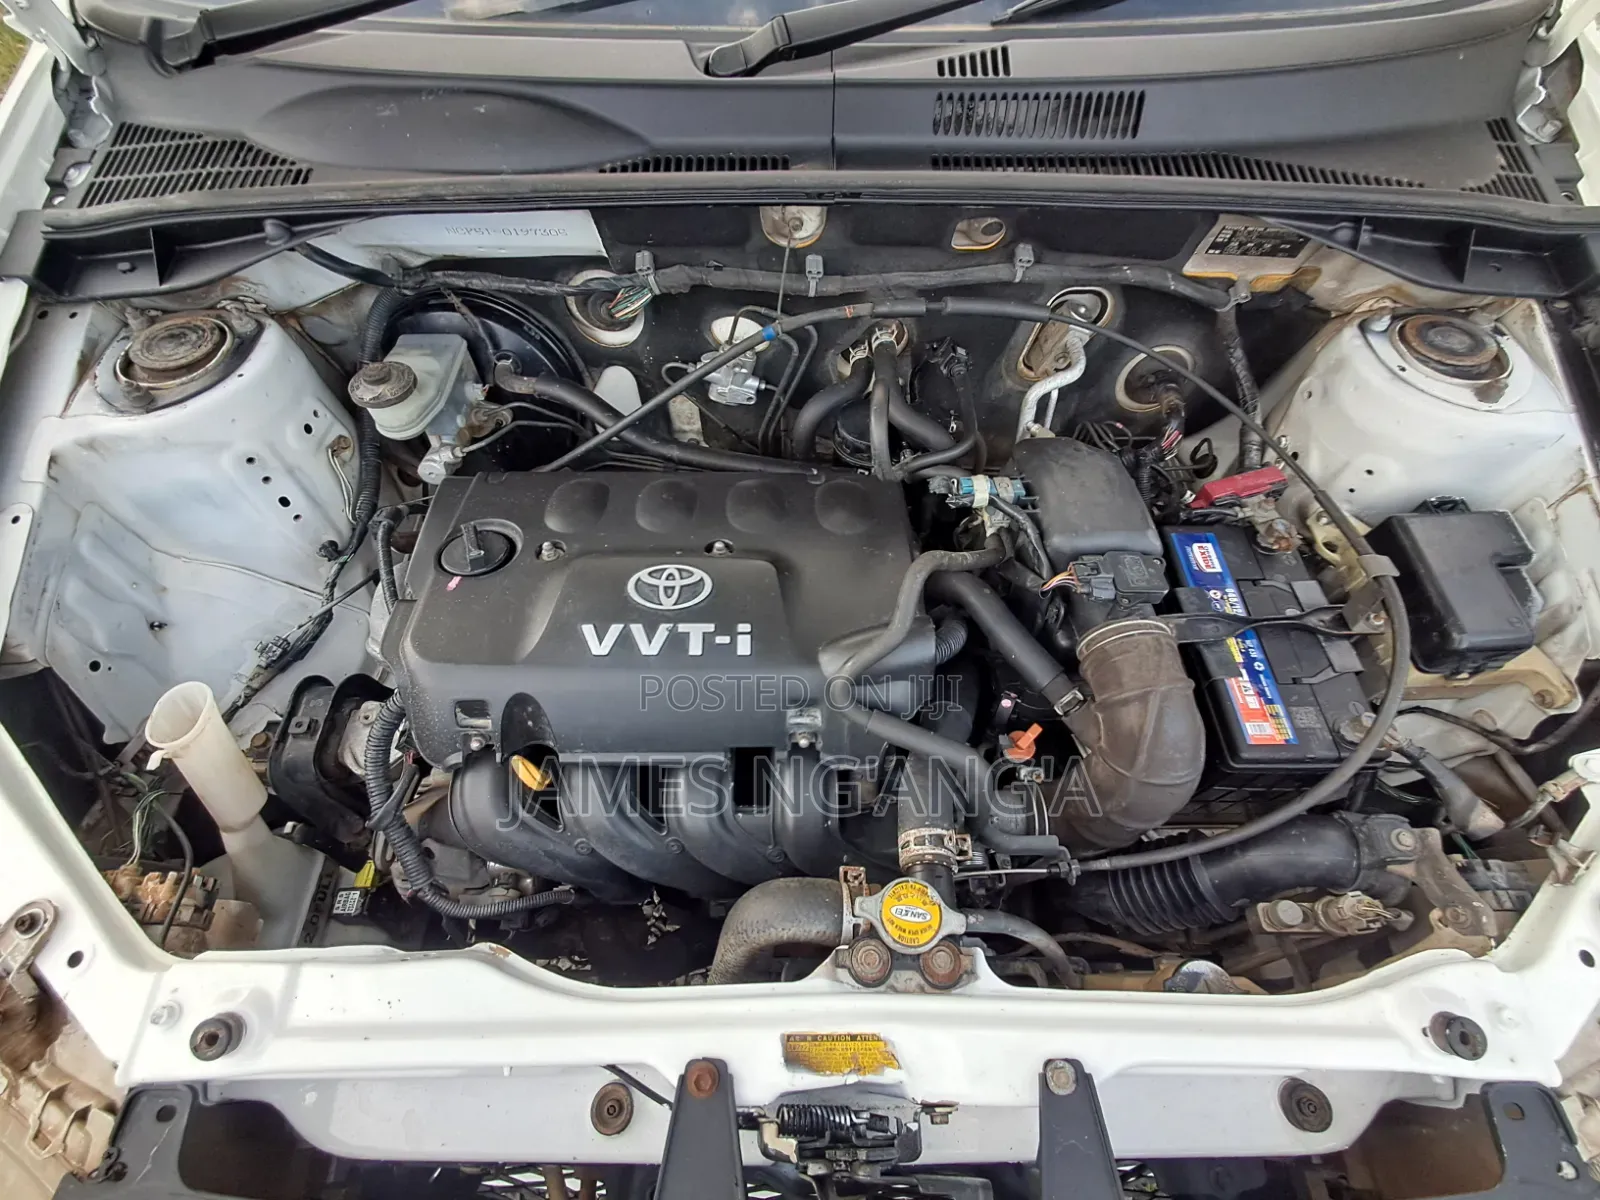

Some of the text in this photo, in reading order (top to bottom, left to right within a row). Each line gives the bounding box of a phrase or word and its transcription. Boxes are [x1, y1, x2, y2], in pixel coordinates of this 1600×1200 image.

[581, 623, 753, 657] VVT-i
[897, 933, 920, 944] CAUTION
[817, 1034, 851, 1042] CAUTION
